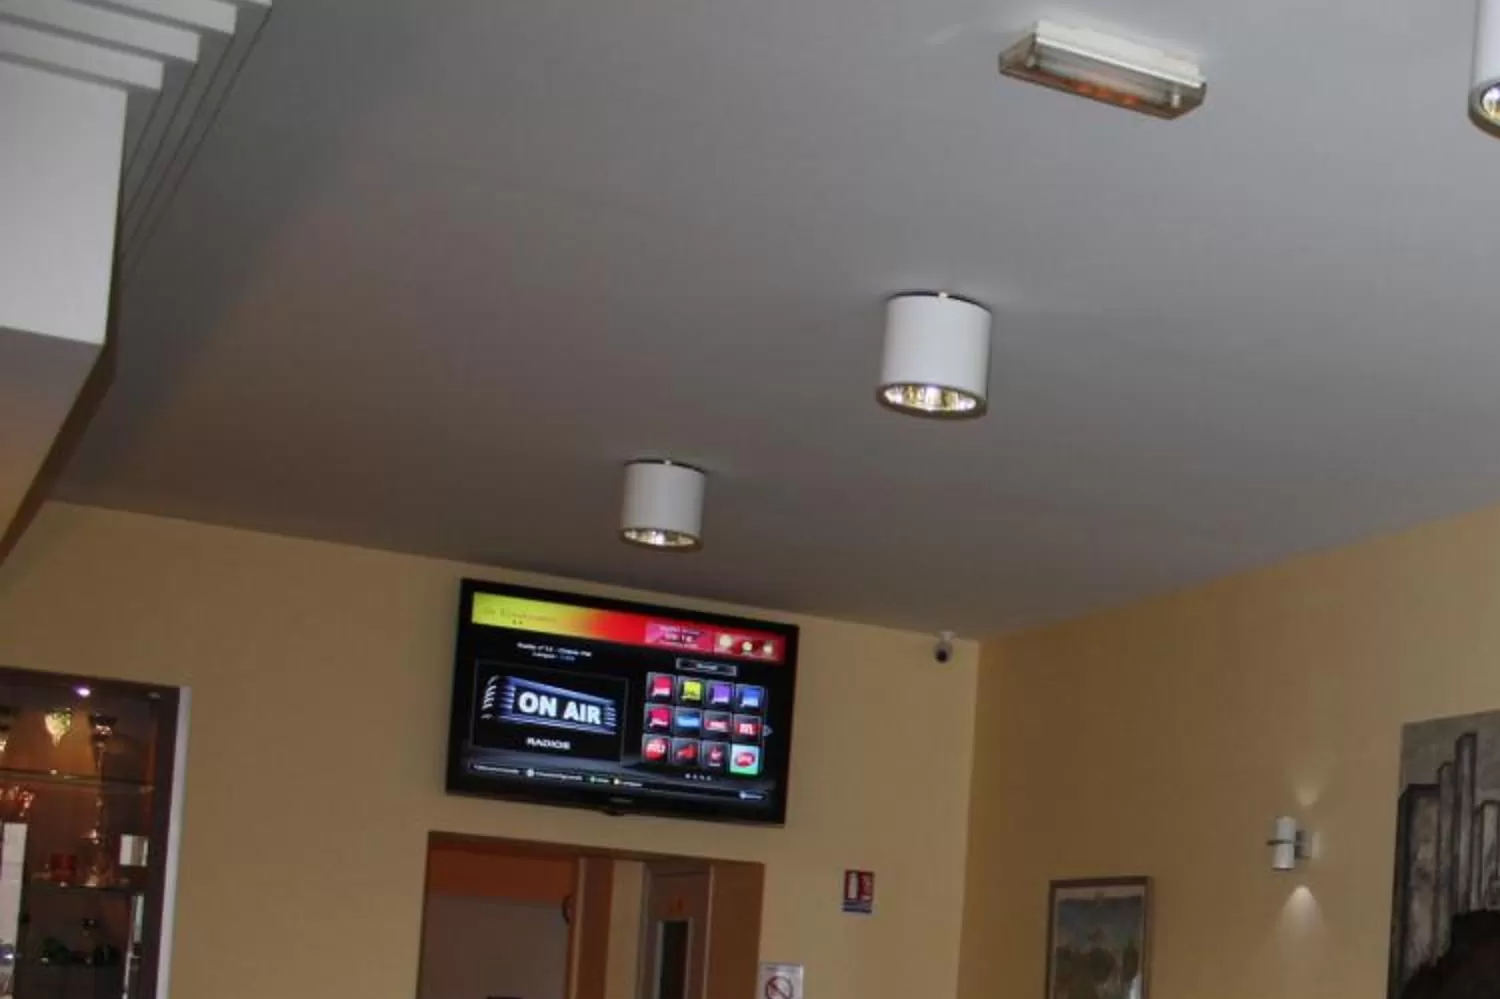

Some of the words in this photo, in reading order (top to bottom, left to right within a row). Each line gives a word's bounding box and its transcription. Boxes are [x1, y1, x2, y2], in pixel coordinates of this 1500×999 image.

[518, 691, 557, 717] ON
[563, 701, 601, 725] AIR
[526, 736, 571, 750] RADIOS
